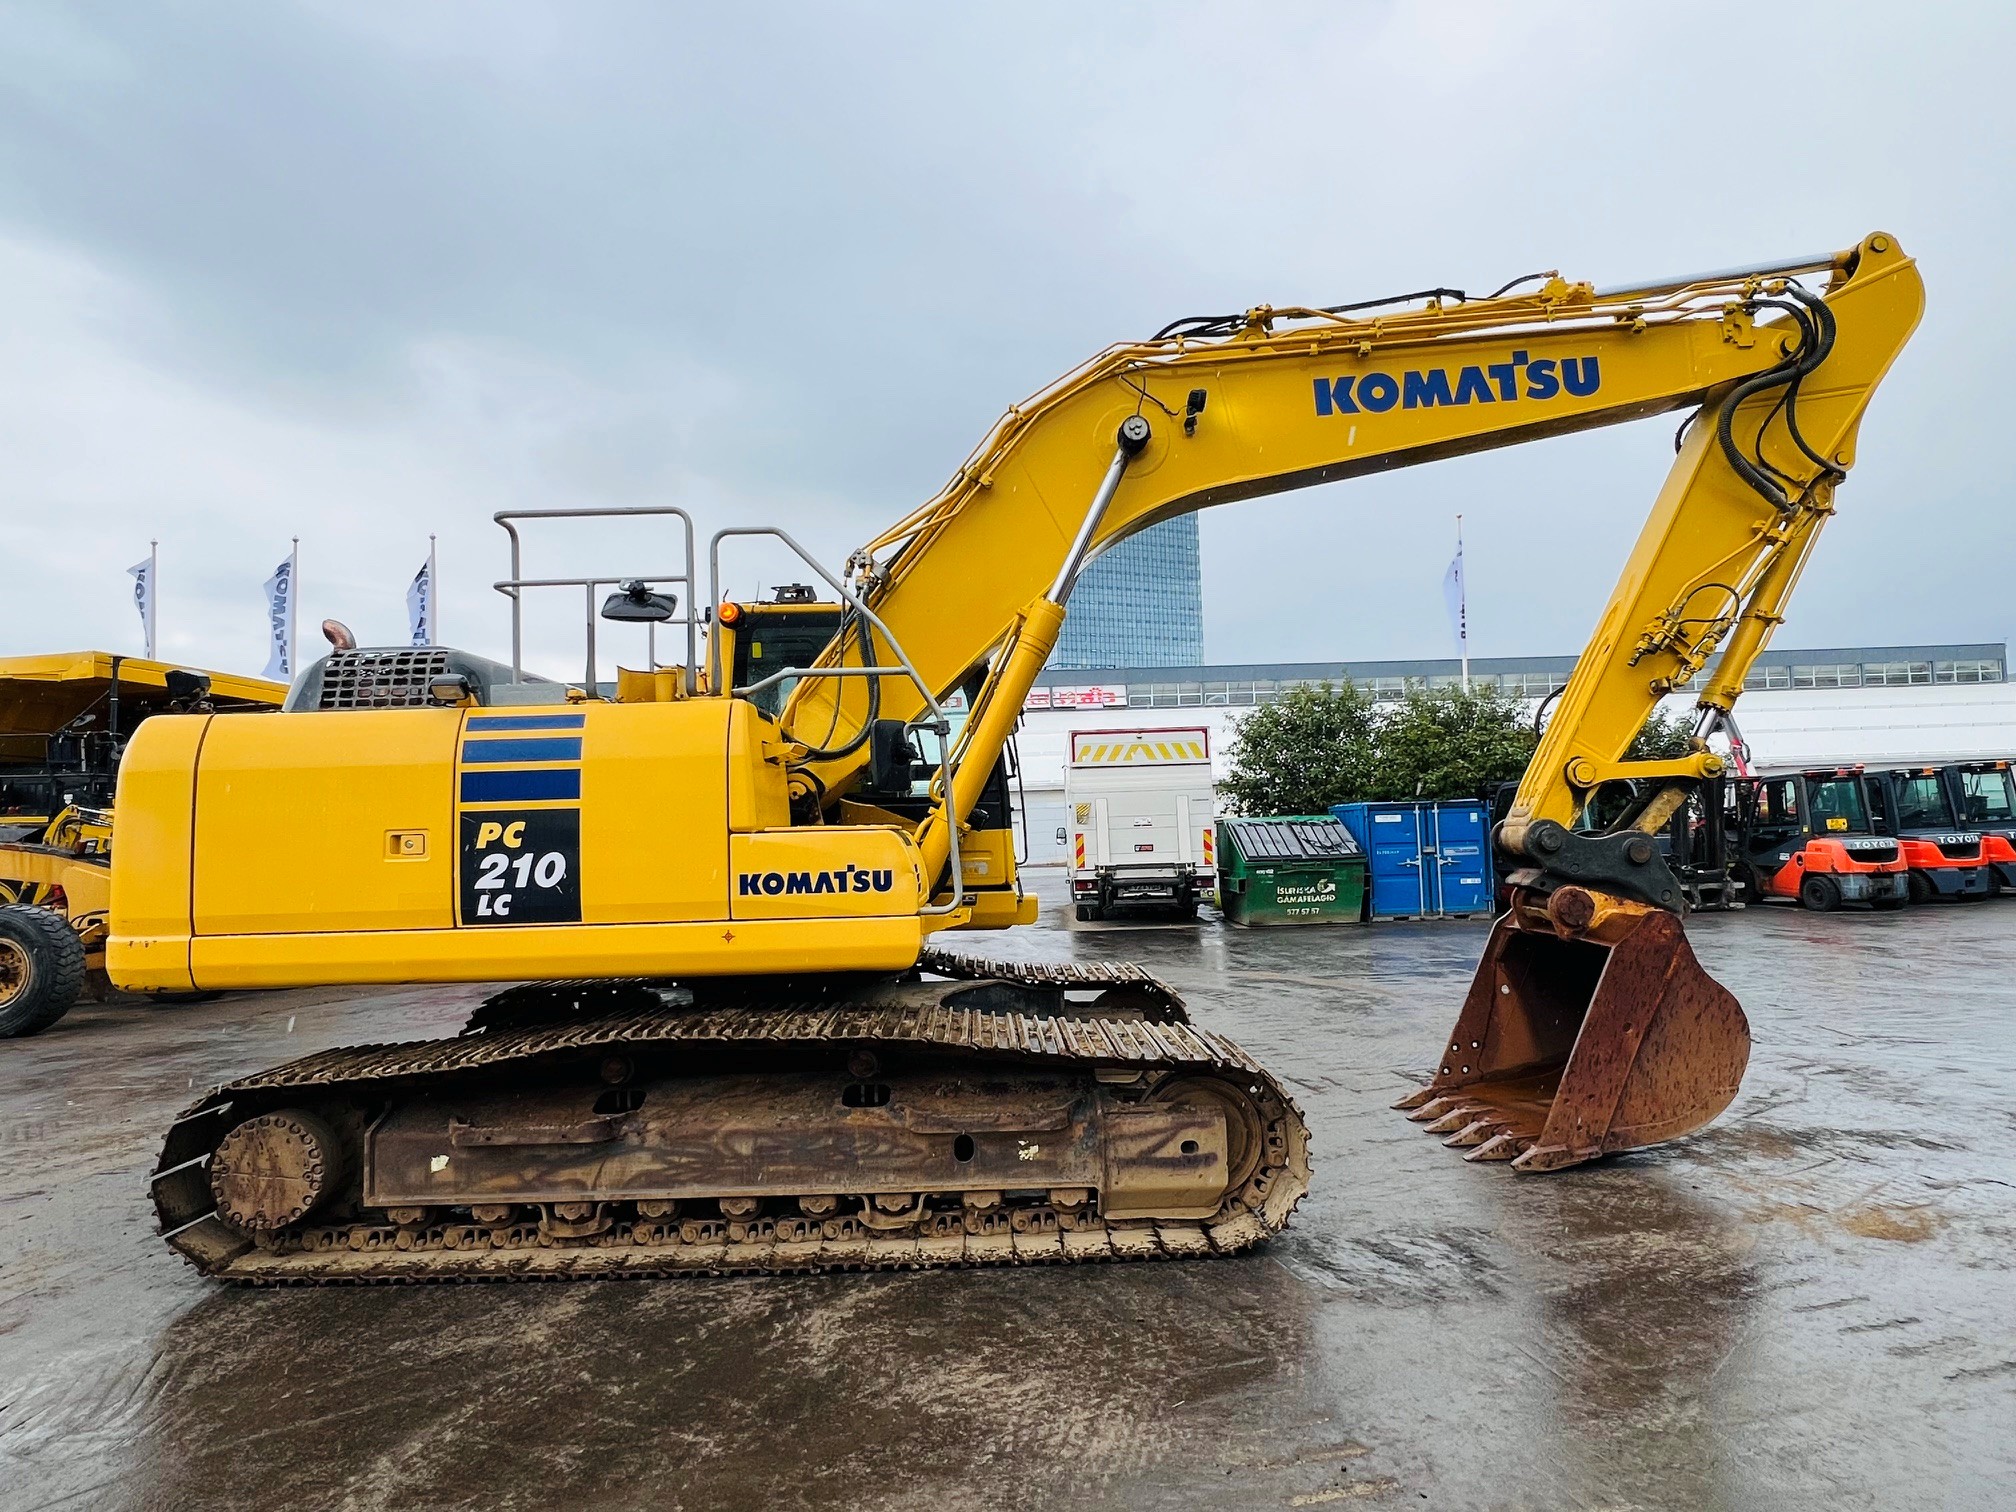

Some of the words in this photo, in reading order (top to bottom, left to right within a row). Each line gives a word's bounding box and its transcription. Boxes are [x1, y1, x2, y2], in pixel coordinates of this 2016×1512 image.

[1313, 350, 1600, 417] KOMATSU
[475, 821, 526, 849] PC
[1853, 840, 1895, 849] TOYOTA
[1937, 833, 1980, 844] TOYOTA
[474, 851, 566, 890] 210
[739, 864, 893, 896] KOMATSU
[477, 893, 512, 916] LC
